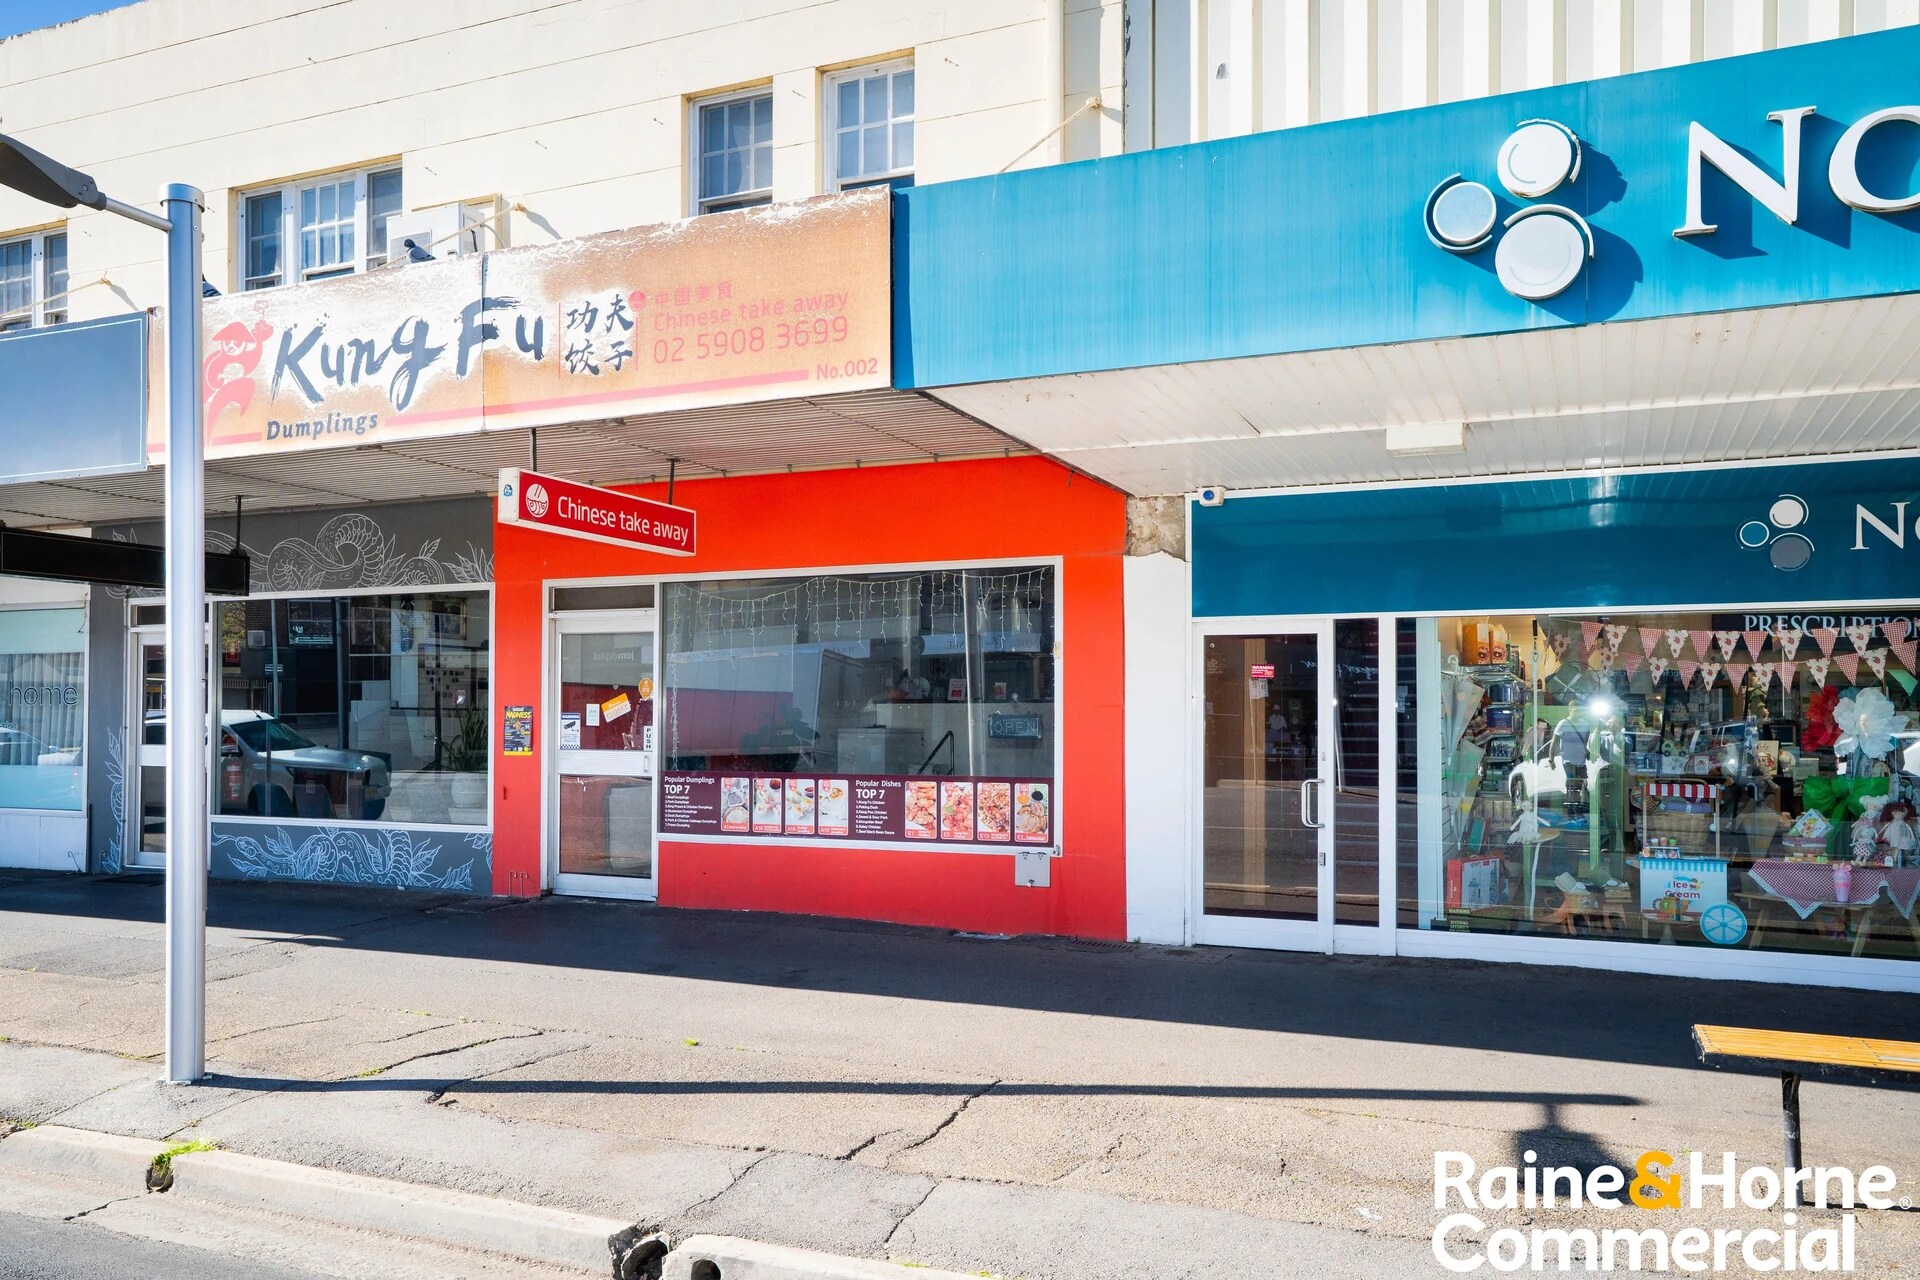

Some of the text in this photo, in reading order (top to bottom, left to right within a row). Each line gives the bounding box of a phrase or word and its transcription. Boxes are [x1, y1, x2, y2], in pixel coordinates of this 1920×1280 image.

[565, 293, 634, 334] 功夫
[654, 291, 848, 331] Chinese take away
[271, 295, 545, 411] Kung Fu
[654, 315, 848, 364] 02 5908 3699
[565, 338, 633, 376] 饺子
[816, 357, 878, 380] No.002
[266, 410, 379, 440] Dumplings
[557, 495, 689, 546] Chinese take away
[1850, 501, 1920, 550] N
[9, 679, 78, 706] home
[505, 711, 532, 719] MADNESS
[606, 704, 629, 718] CLOSED
[994, 720, 1036, 735] OPEN
[664, 784, 690, 794] TOP 7
[855, 789, 885, 799] TOP 7
[1665, 890, 1701, 899] Cream
[1673, 880, 1688, 889] Ice
